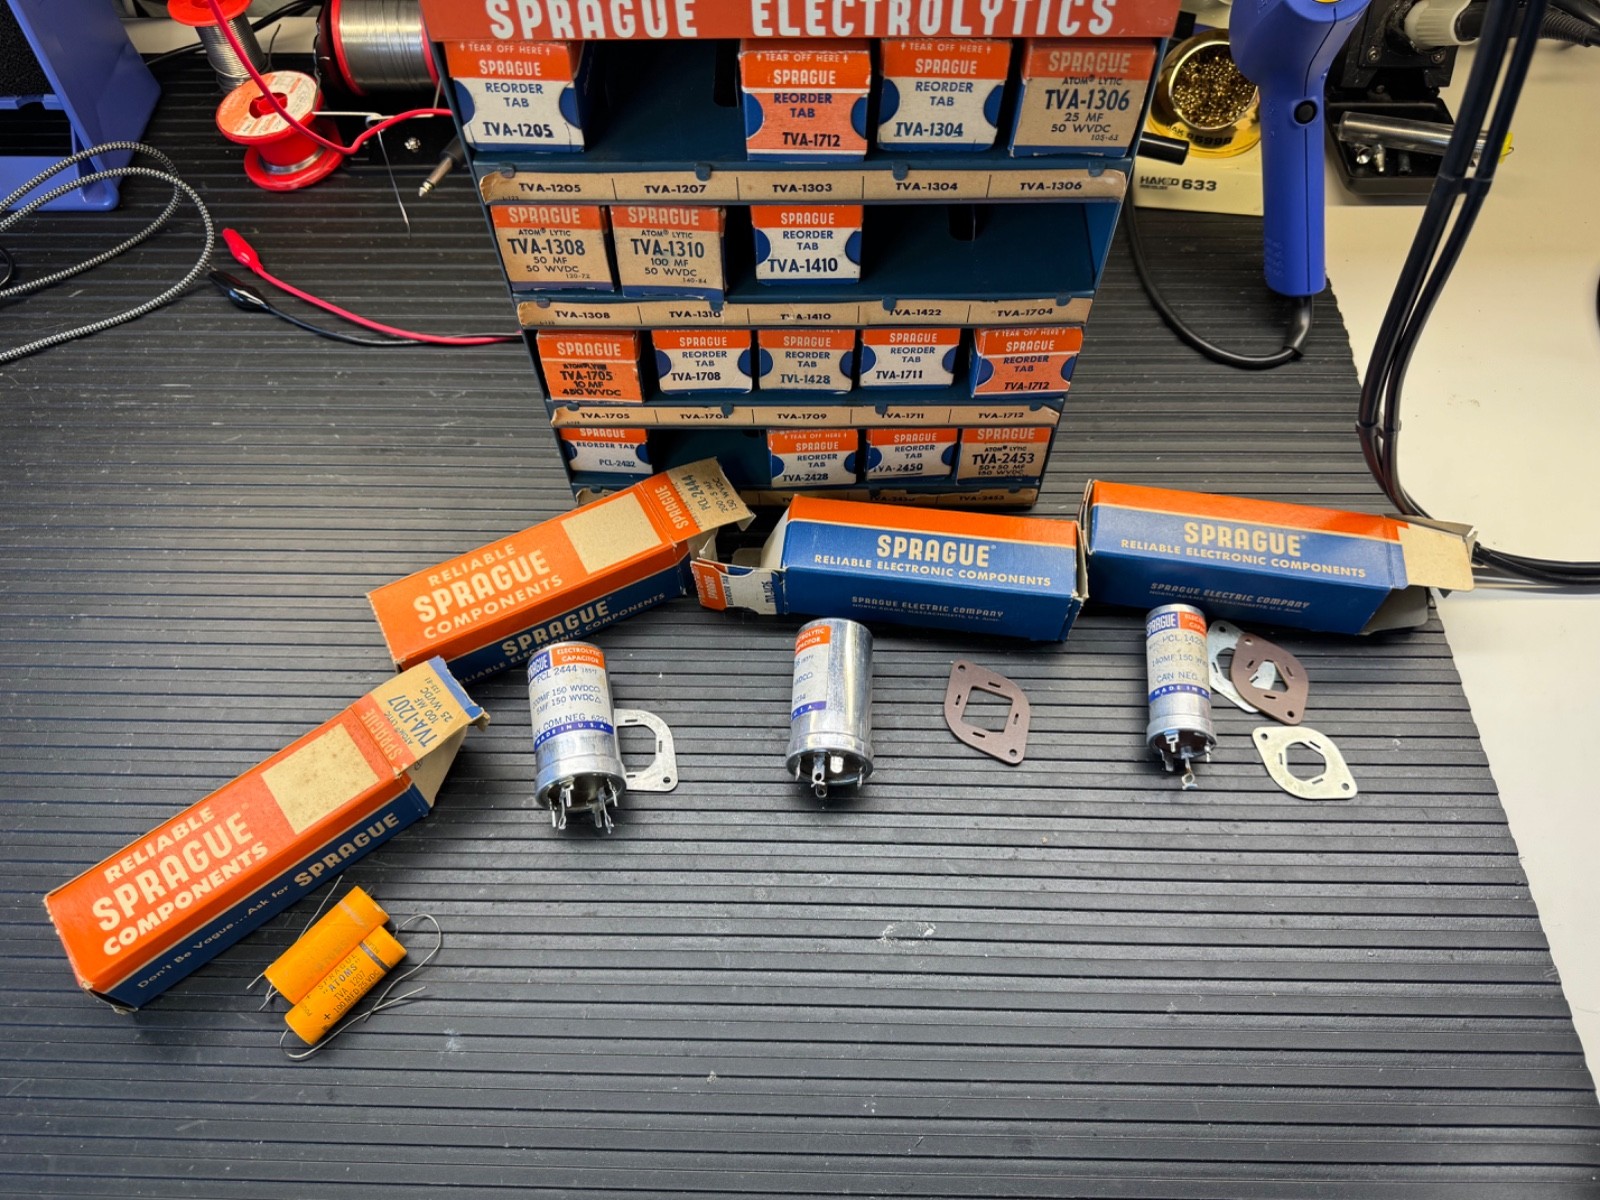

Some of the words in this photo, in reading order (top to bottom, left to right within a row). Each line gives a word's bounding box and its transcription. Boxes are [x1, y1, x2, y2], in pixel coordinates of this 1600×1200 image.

[486, 0, 698, 39] SPRAGUE
[752, 0, 1118, 38] ELECTROLYTICS
[469, 44, 495, 54] TEAR
[498, 44, 513, 54] OFF
[518, 45, 543, 55] HERE
[909, 43, 932, 51] TEAR
[937, 43, 955, 52] OFF
[959, 44, 982, 53] HERE
[765, 53, 789, 62] TEAR
[793, 54, 812, 62] OFF
[816, 54, 840, 63] HERE
[1048, 50, 1131, 73] SPRAGUE
[479, 59, 542, 77] SPRAGUE
[915, 59, 978, 75] SPRAGUE
[773, 69, 836, 85] SPRAGUE
[1098, 77, 1123, 86] LYTIC
[485, 82, 543, 95] REORDER
[915, 81, 973, 93] REORDER
[503, 97, 530, 108] TAB
[774, 93, 832, 104] REORDER
[929, 96, 955, 107] TAB
[1044, 89, 1130, 111] TVA-1306
[790, 107, 815, 118] TAB
[1063, 112, 1080, 122] 25
[1084, 113, 1104, 122] MF
[482, 122, 554, 138] TVA-1205
[894, 122, 964, 137] TVA-1304
[1050, 123, 1068, 133] 50
[1073, 123, 1111, 133] WVDC
[782, 132, 841, 148] TVA-1712
[519, 182, 581, 193] TVA-1205
[644, 184, 706, 194] TVA-1207
[772, 184, 833, 193] TVA-1303
[895, 182, 958, 191] TVA-1304
[1020, 181, 1082, 191] TVA-1306
[1182, 179, 1217, 191] 633
[508, 207, 581, 224] SPRAGUE
[628, 208, 699, 225] SPRAGUE
[781, 212, 835, 225] SPRAGUE
[672, 231, 693, 239] LYTIC
[783, 230, 834, 239] REORDER
[507, 238, 586, 256] TVA-1308
[630, 238, 705, 258] TVA-1310
[797, 242, 818, 250] TAB
[534, 256, 548, 264] 50
[553, 257, 568, 265] MF
[650, 258, 669, 266] 100
[674, 259, 689, 267] MF
[767, 258, 838, 273] TVA-1410
[544, 265, 579, 273] WVDC
[645, 267, 658, 275] 50
[663, 268, 697, 277] WVDC
[555, 310, 611, 319] TVA-1308
[669, 310, 721, 318] TVA-1310
[997, 308, 1053, 316] TVA-1704
[679, 337, 727, 346] SPRAGUE
[783, 336, 831, 347] SPRAGUE
[889, 333, 938, 343] SPRAGUE
[557, 342, 621, 356] SPRAGUE
[1006, 340, 1055, 352] SPRAGUE
[785, 351, 830, 359] REORDER
[1003, 355, 1049, 364] REORDER
[797, 360, 817, 368] TAB
[560, 371, 613, 380] TVA-1705
[671, 372, 721, 381] TVA-1708
[780, 374, 831, 384] TVL-1428
[876, 370, 923, 380] TVA-1711
[1004, 382, 1050, 390] TVA-1712
[579, 428, 626, 438] SPRAGUE
[894, 433, 937, 442] SPRAGUE
[977, 428, 1035, 440] SPRAGUE
[796, 441, 839, 451] SPRAGUE
[972, 453, 1034, 465] TVA-2453
[783, 473, 829, 482] TVA-2428
[655, 485, 689, 529] SPRAGUE
[1184, 522, 1301, 556] SPRAGUE
[877, 535, 989, 567] SPRAGUE
[428, 543, 516, 586] RELIABLE
[1121, 539, 1181, 555] RELIABLE
[1186, 546, 1267, 565] ELECTRONIC
[1271, 557, 1366, 579] COMPONENTS
[815, 554, 874, 570] RELIABLE
[877, 561, 954, 578] ELECTRONIC
[959, 568, 1051, 586] COMPONENTS
[412, 549, 552, 623] SPRAGUE
[1151, 583, 1200, 595] SPRAGUE
[1203, 589, 1253, 602] ELECTRIC
[1256, 596, 1311, 609] COMPANY
[423, 574, 563, 640] COMPONENTS
[852, 596, 898, 607] SPRAGUE
[902, 602, 949, 612] ELECTRIC
[953, 607, 1004, 617] COMPANY
[501, 600, 610, 657] SPRAGUE
[459, 661, 506, 685] ELIABLE
[586, 593, 665, 632] COMPONENTS
[562, 655, 599, 664] CAPACITOR
[554, 665, 577, 676] 2444
[552, 686, 567, 696] 150
[1154, 686, 1180, 696] MADE
[414, 698, 428, 709] MF
[420, 687, 443, 710] WVDC
[552, 697, 566, 706] 150
[387, 695, 438, 748] TVA-1207
[425, 710, 438, 724] 100
[440, 711, 454, 723] 25
[361, 708, 403, 760] SPRAGUE
[536, 728, 556, 745] MADE
[104, 806, 215, 884] RELIABLE
[92, 812, 254, 931] SPRAGUE
[102, 843, 269, 956] COMPONENTS
[137, 960, 172, 989] Don't
[174, 950, 192, 965] Be
[271, 884, 290, 901] for
[293, 812, 400, 888] SPRAGUE
[334, 987, 349, 1000] TVA
[350, 971, 366, 987] 1207
